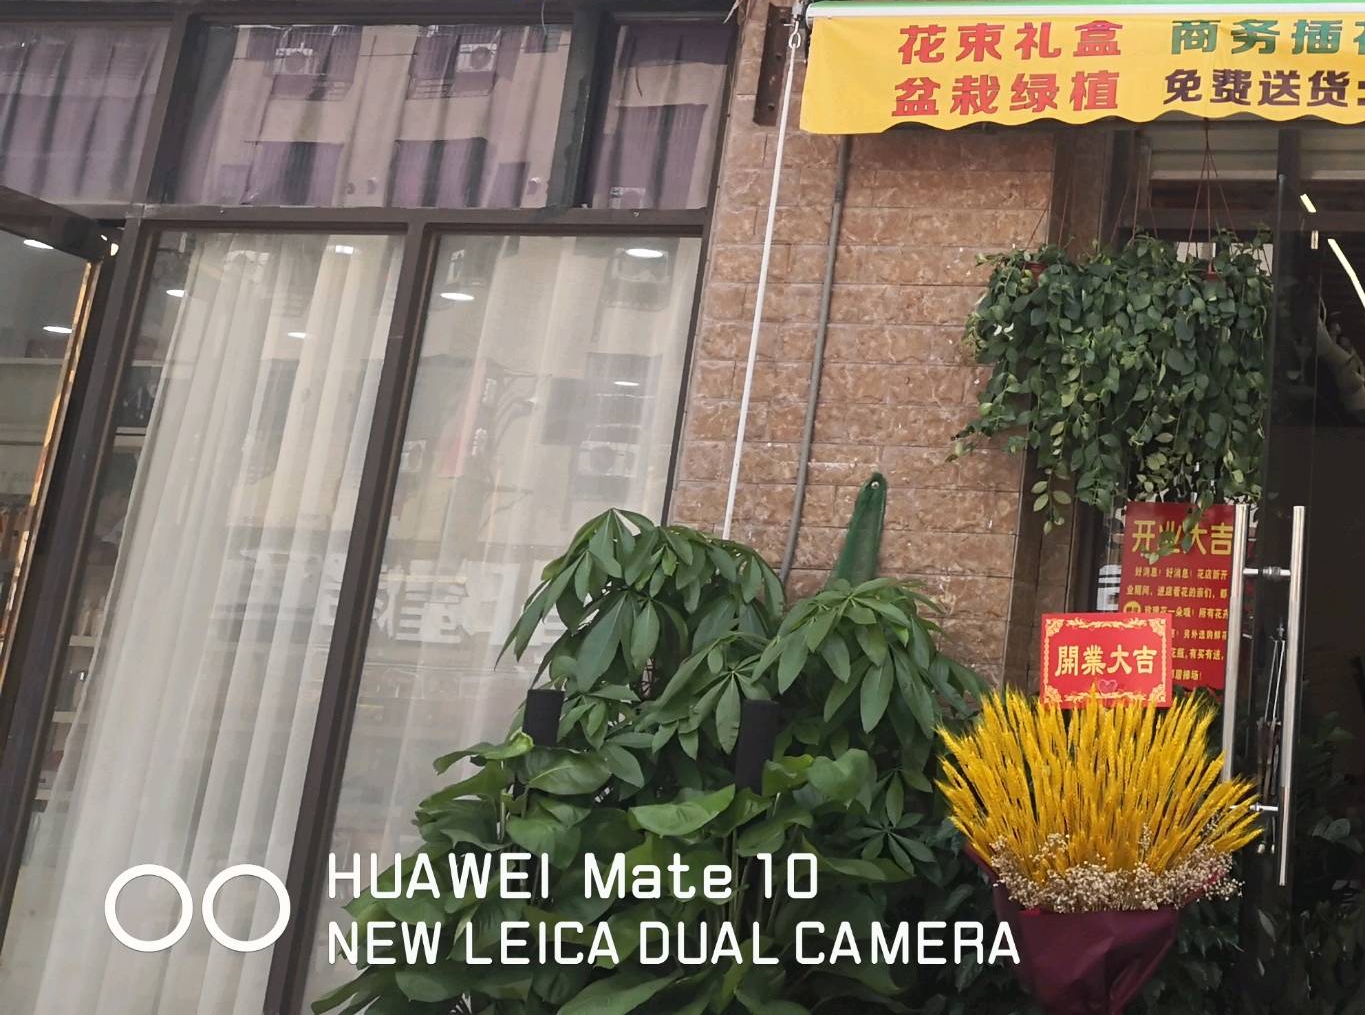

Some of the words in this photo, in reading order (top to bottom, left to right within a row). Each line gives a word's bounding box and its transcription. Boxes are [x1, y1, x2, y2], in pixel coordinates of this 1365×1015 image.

[898, 20, 1123, 65] 花束礼盒
[891, 69, 1120, 117] 盆栽绿植
[1055, 645, 1157, 676] 開業大吉
